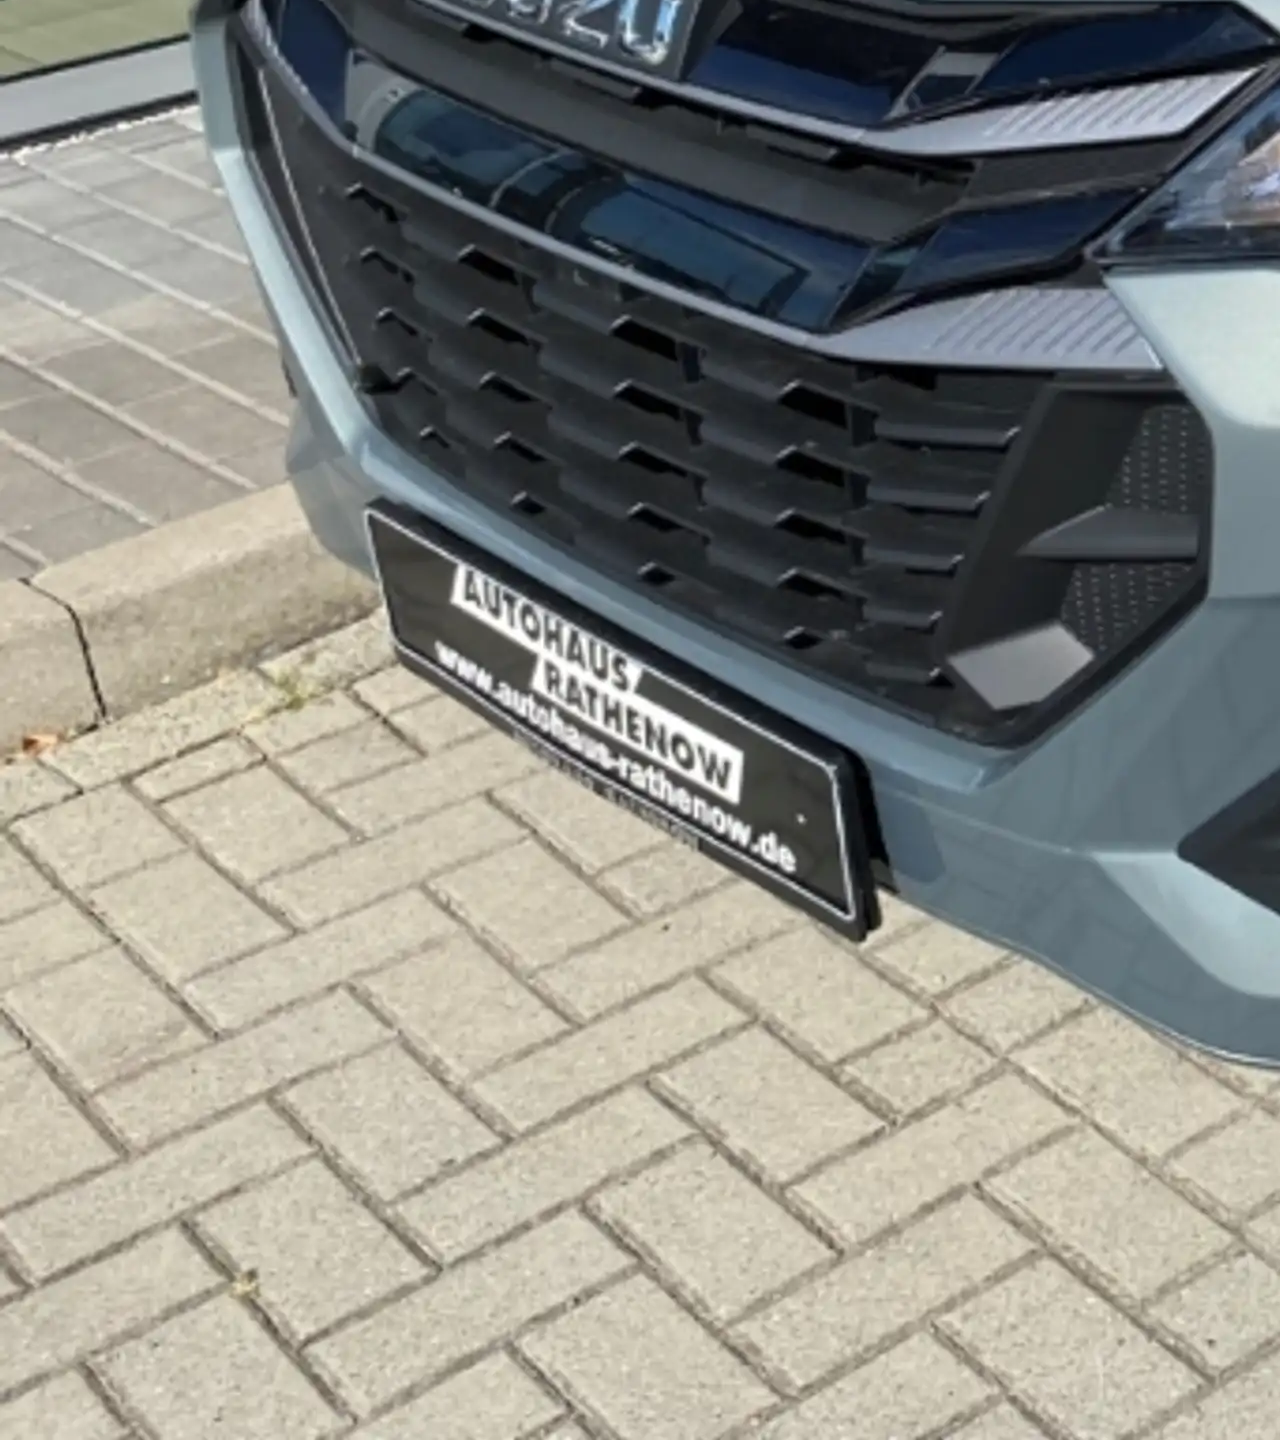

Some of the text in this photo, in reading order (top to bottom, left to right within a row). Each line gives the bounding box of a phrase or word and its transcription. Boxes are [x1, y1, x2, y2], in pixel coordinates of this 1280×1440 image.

[461, 570, 633, 690] AUTOHAUS
[434, 641, 798, 875] www.autohaus-rathenow.de
[542, 665, 735, 793] RATHENOW
